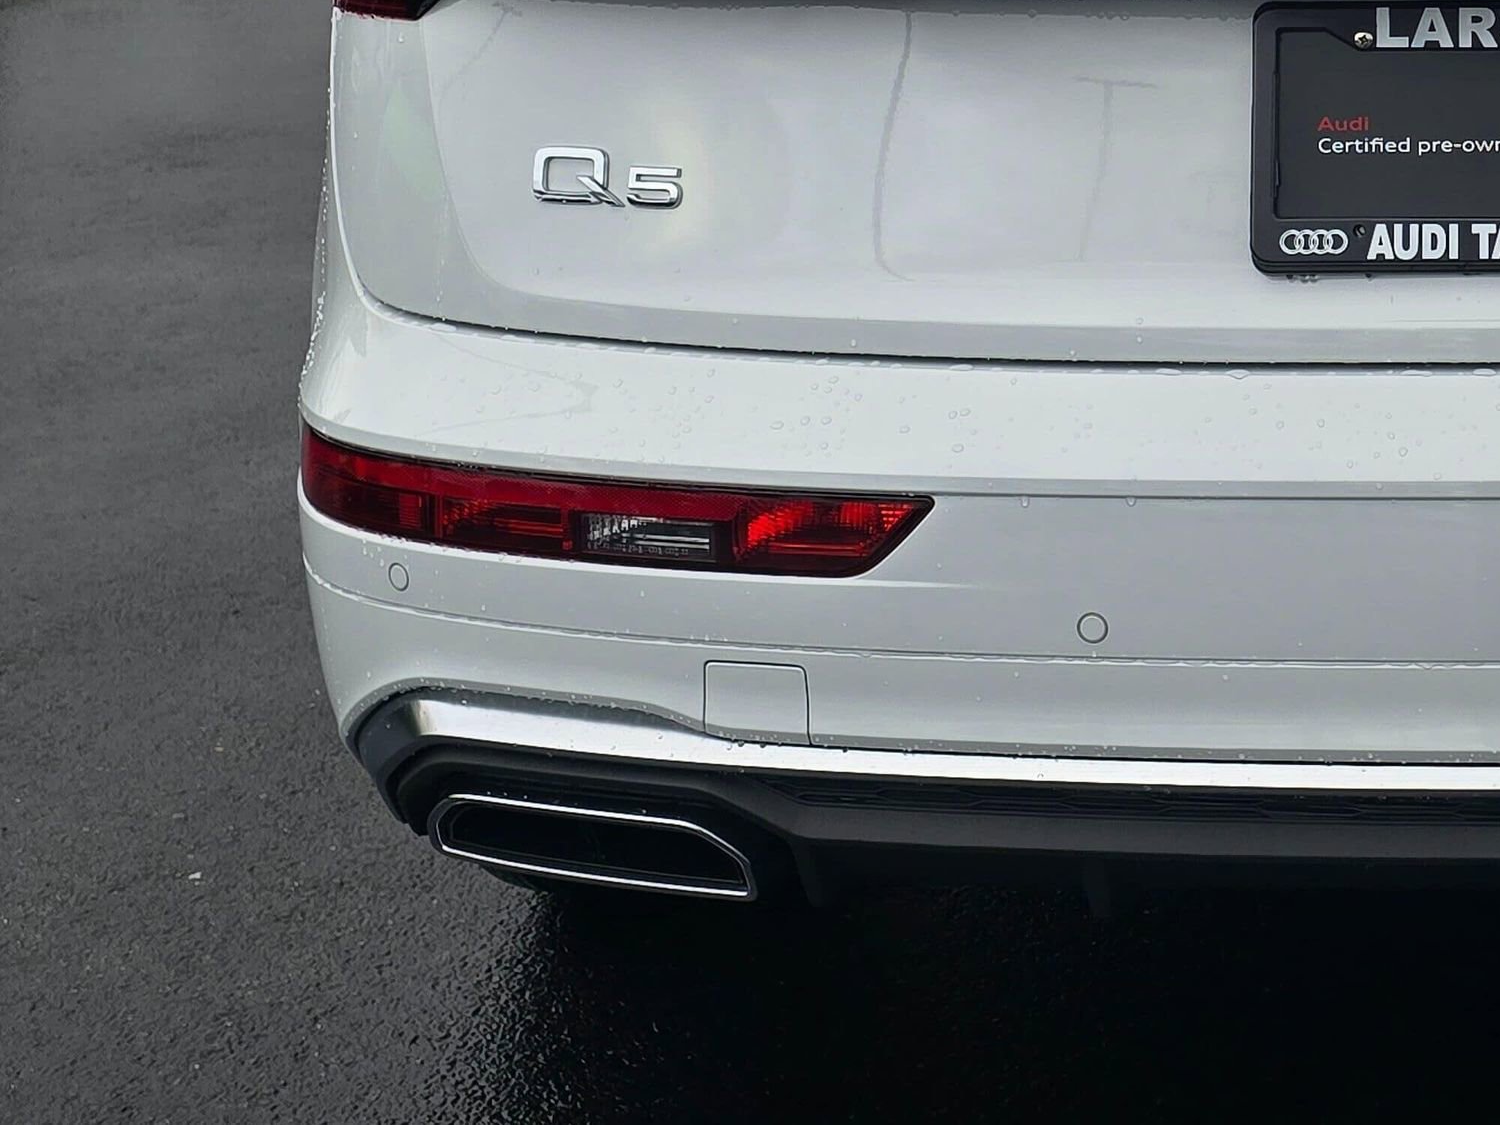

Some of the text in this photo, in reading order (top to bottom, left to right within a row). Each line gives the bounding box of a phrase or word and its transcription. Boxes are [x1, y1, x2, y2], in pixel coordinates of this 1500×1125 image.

[1317, 116, 1370, 132] Audi
[1318, 137, 1411, 154] Certified
[533, 145, 684, 210] Q5
[1366, 223, 1459, 261] AUDI
